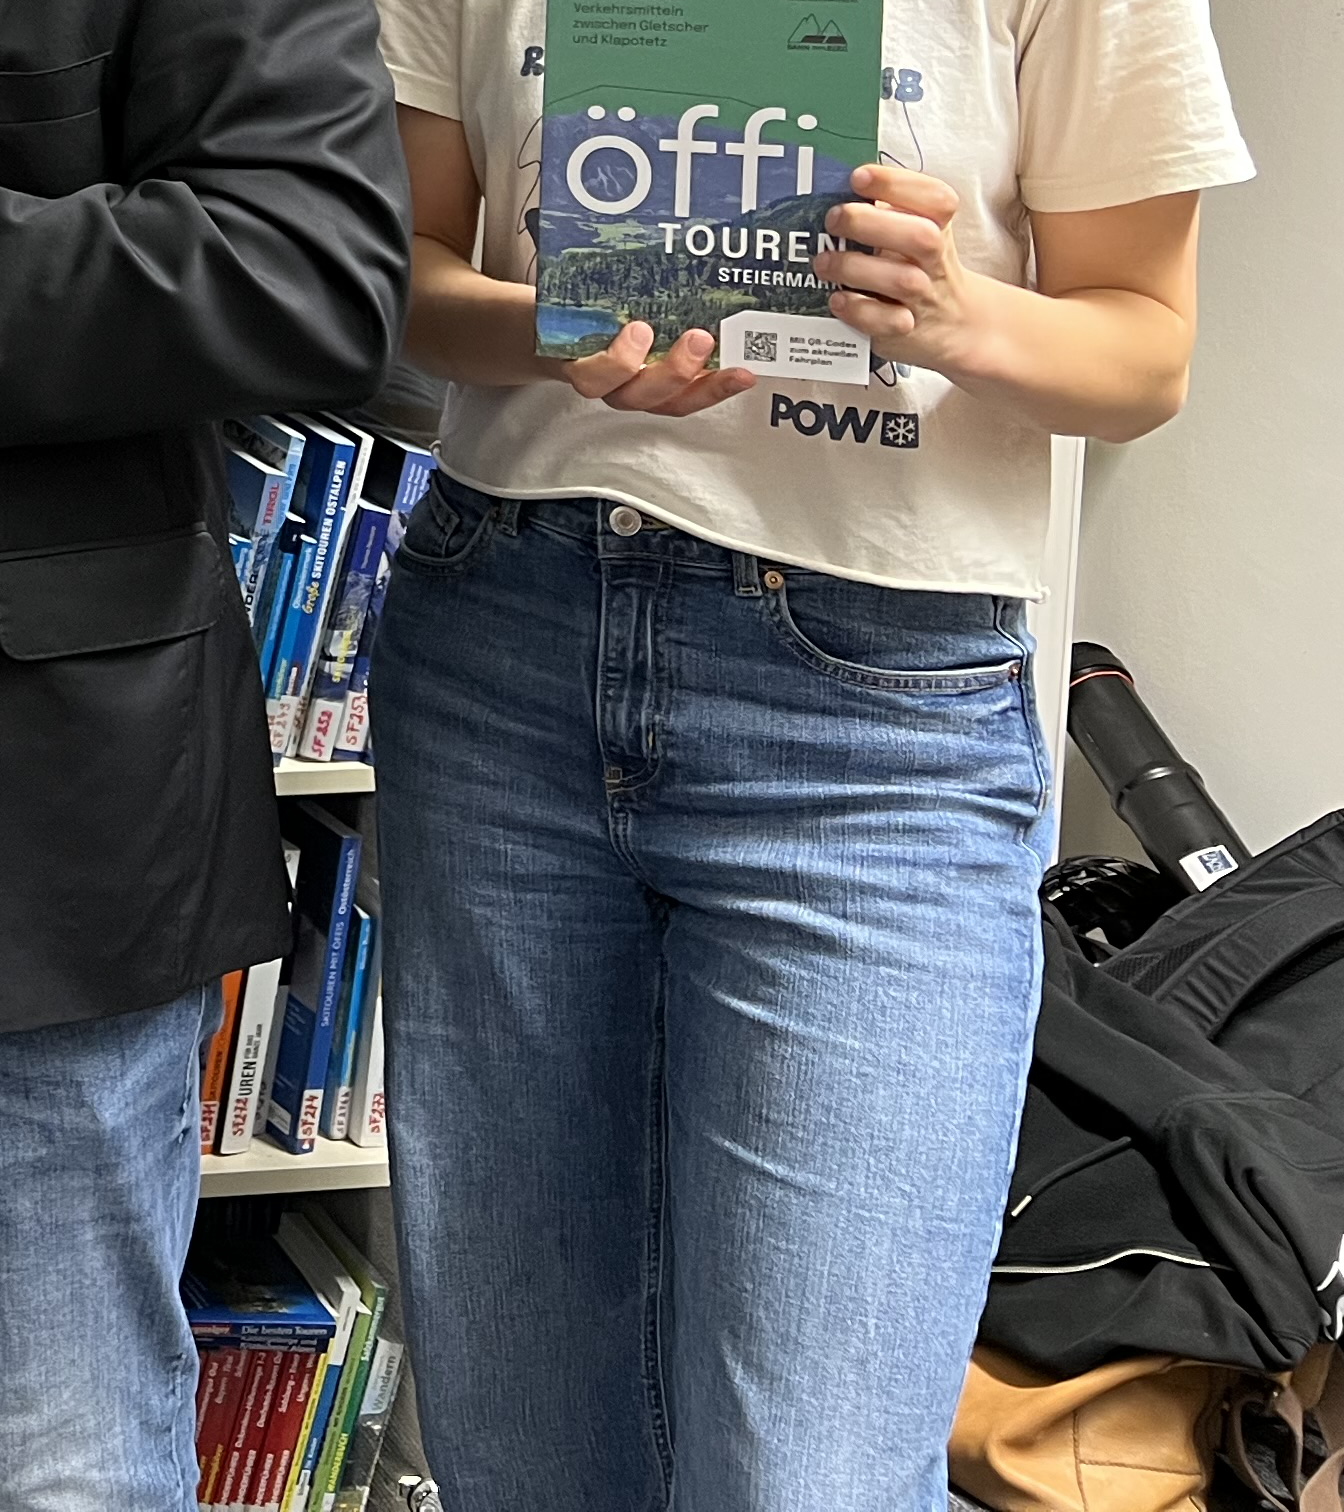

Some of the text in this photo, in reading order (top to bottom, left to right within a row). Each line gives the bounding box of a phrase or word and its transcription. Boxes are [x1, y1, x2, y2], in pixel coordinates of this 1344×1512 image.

[573, 2, 684, 17] Verkehrsmitteln
[572, 19, 710, 33] zwischen Gletscher
[572, 34, 668, 48] und Klapotetz
[566, 104, 819, 218] öffi
[658, 222, 846, 264] TOUREN
[788, 355, 834, 367] Fahrplan
[770, 392, 881, 445] POW
[311, 518, 335, 579] SKITOUREN
[325, 459, 347, 517] OSTALPEN
[261, 1326, 293, 1335] besten
[295, 1325, 328, 1335] Touren
[372, 1355, 397, 1412] Wandern
